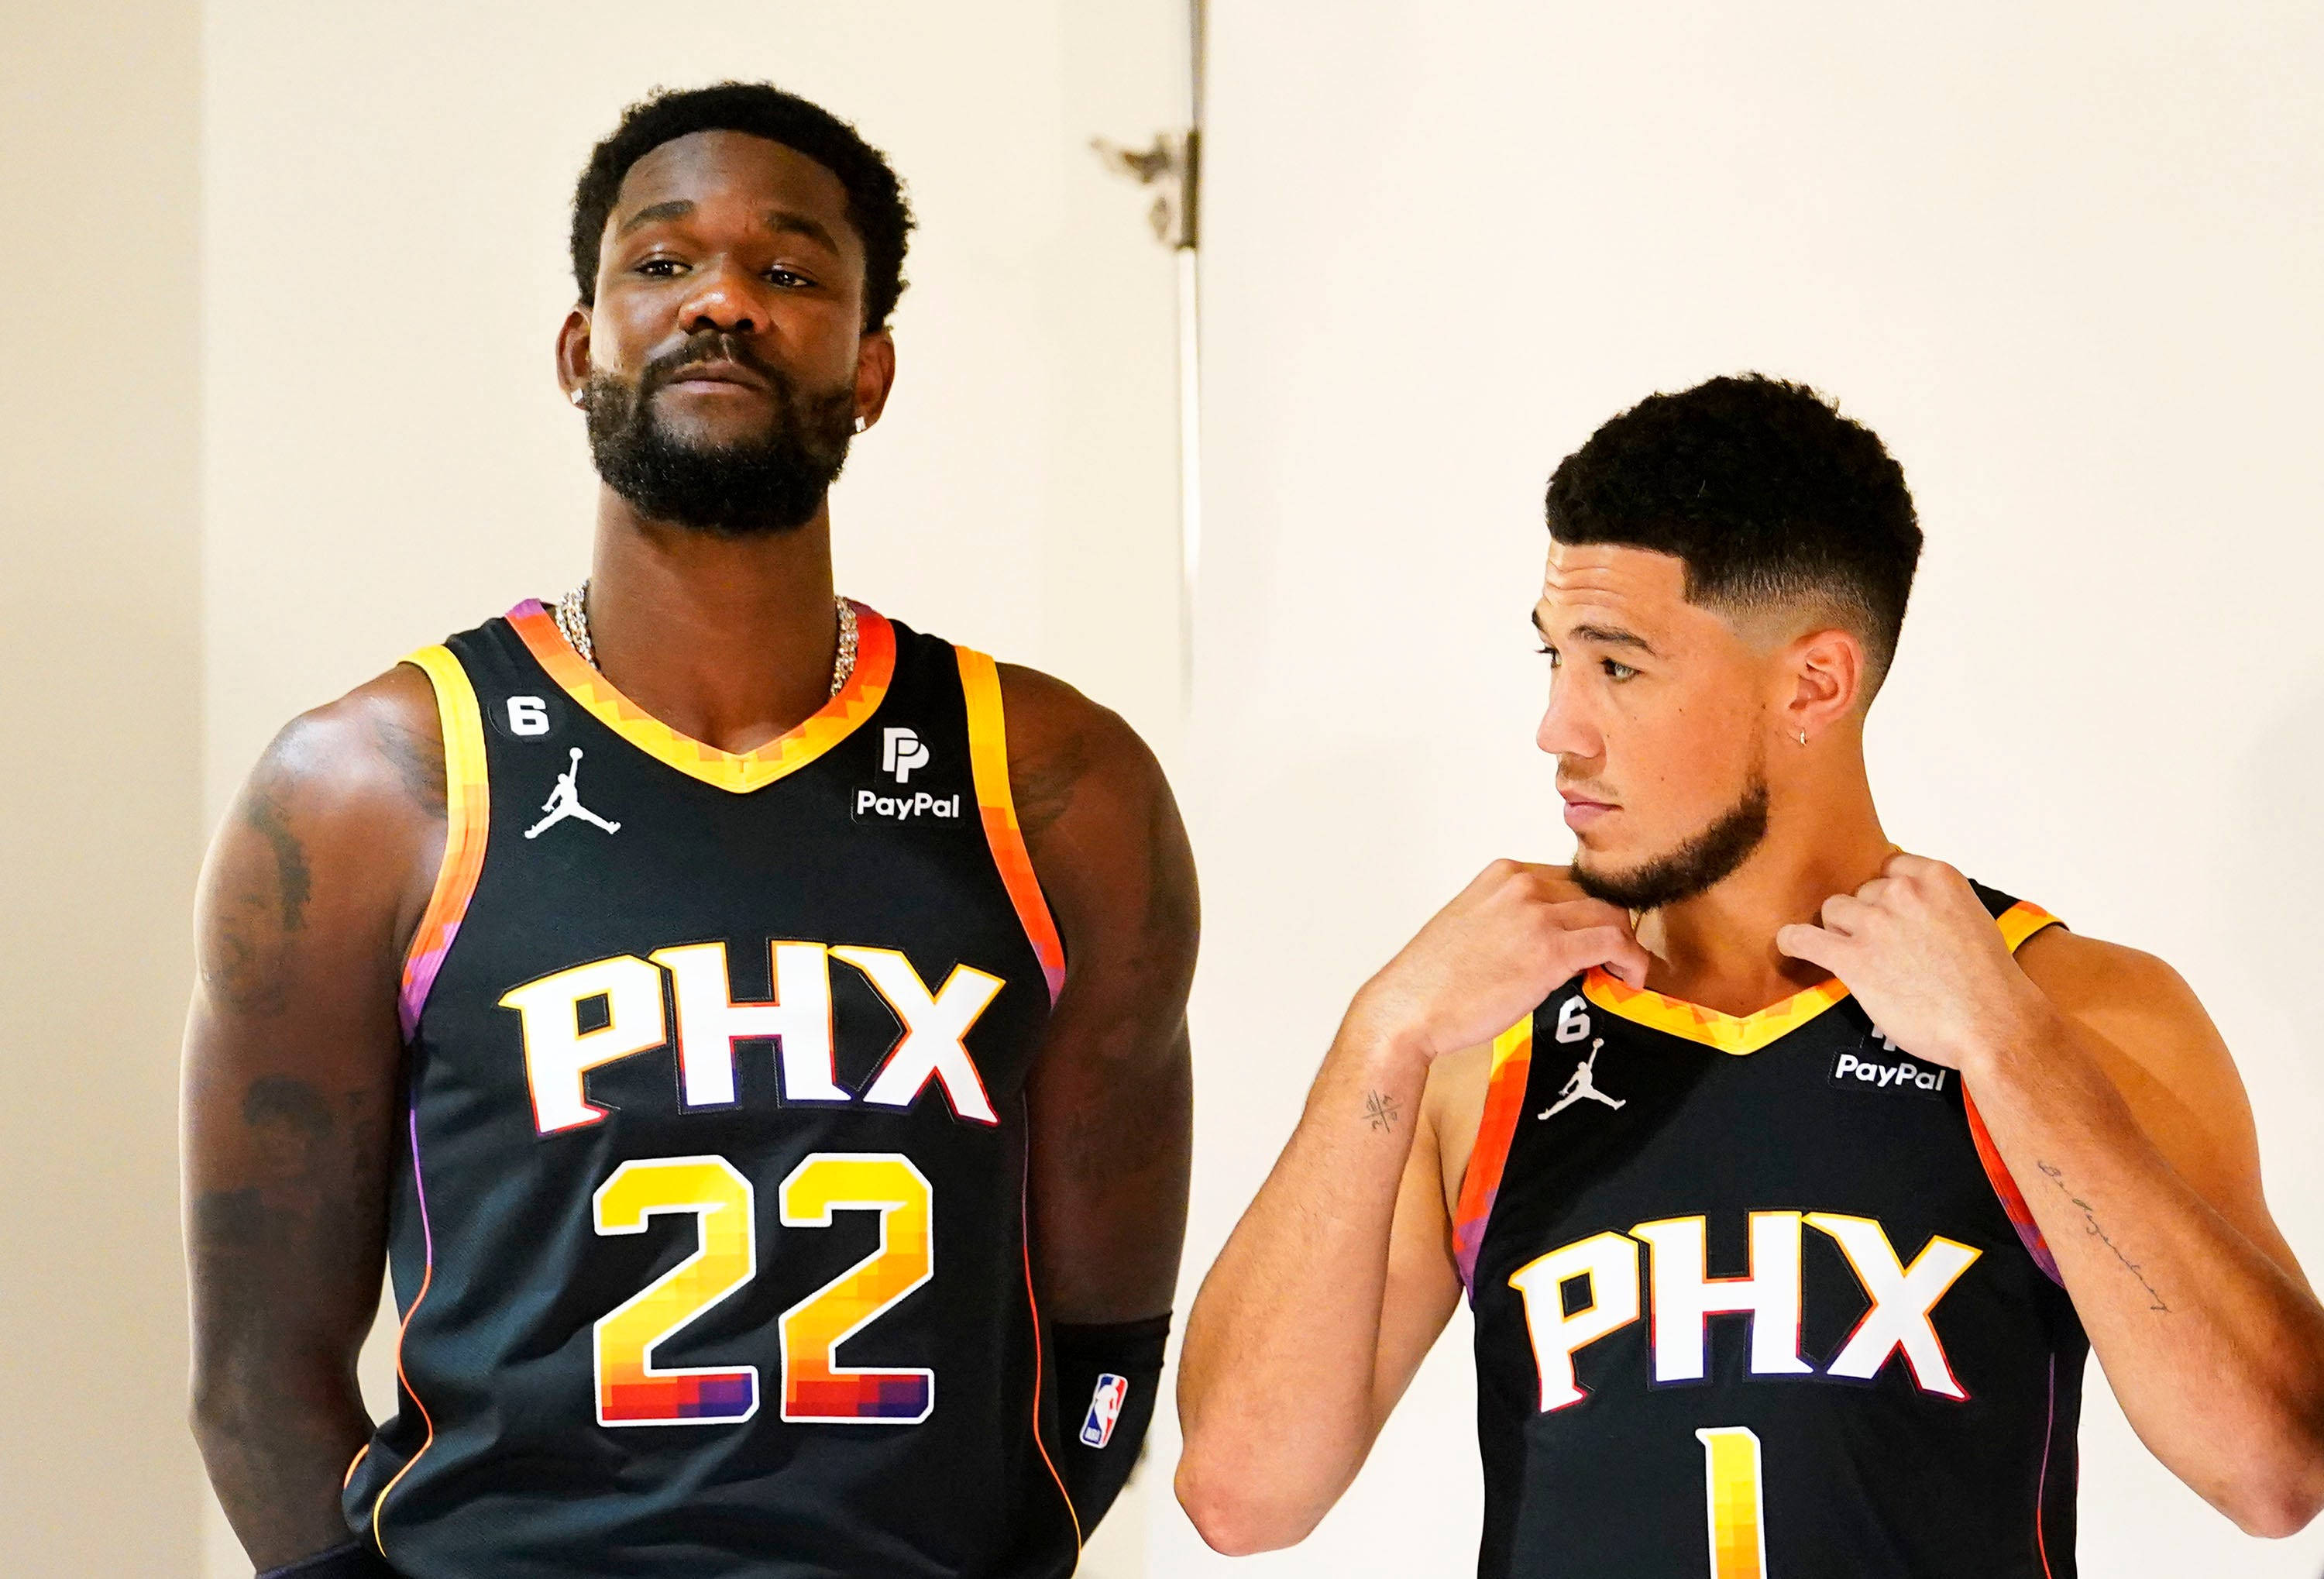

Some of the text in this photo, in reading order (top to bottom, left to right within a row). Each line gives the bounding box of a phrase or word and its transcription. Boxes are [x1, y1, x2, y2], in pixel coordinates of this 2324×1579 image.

[507, 696, 550, 736] 6
[857, 790, 960, 820] PayPal
[498, 940, 1006, 1135] PHX
[1556, 994, 1590, 1044] 6
[1835, 1054, 1946, 1091] PayPal
[593, 1153, 933, 1427] 22
[1508, 1211, 1983, 1413] PHX
[1695, 1426, 1768, 1579] 1
